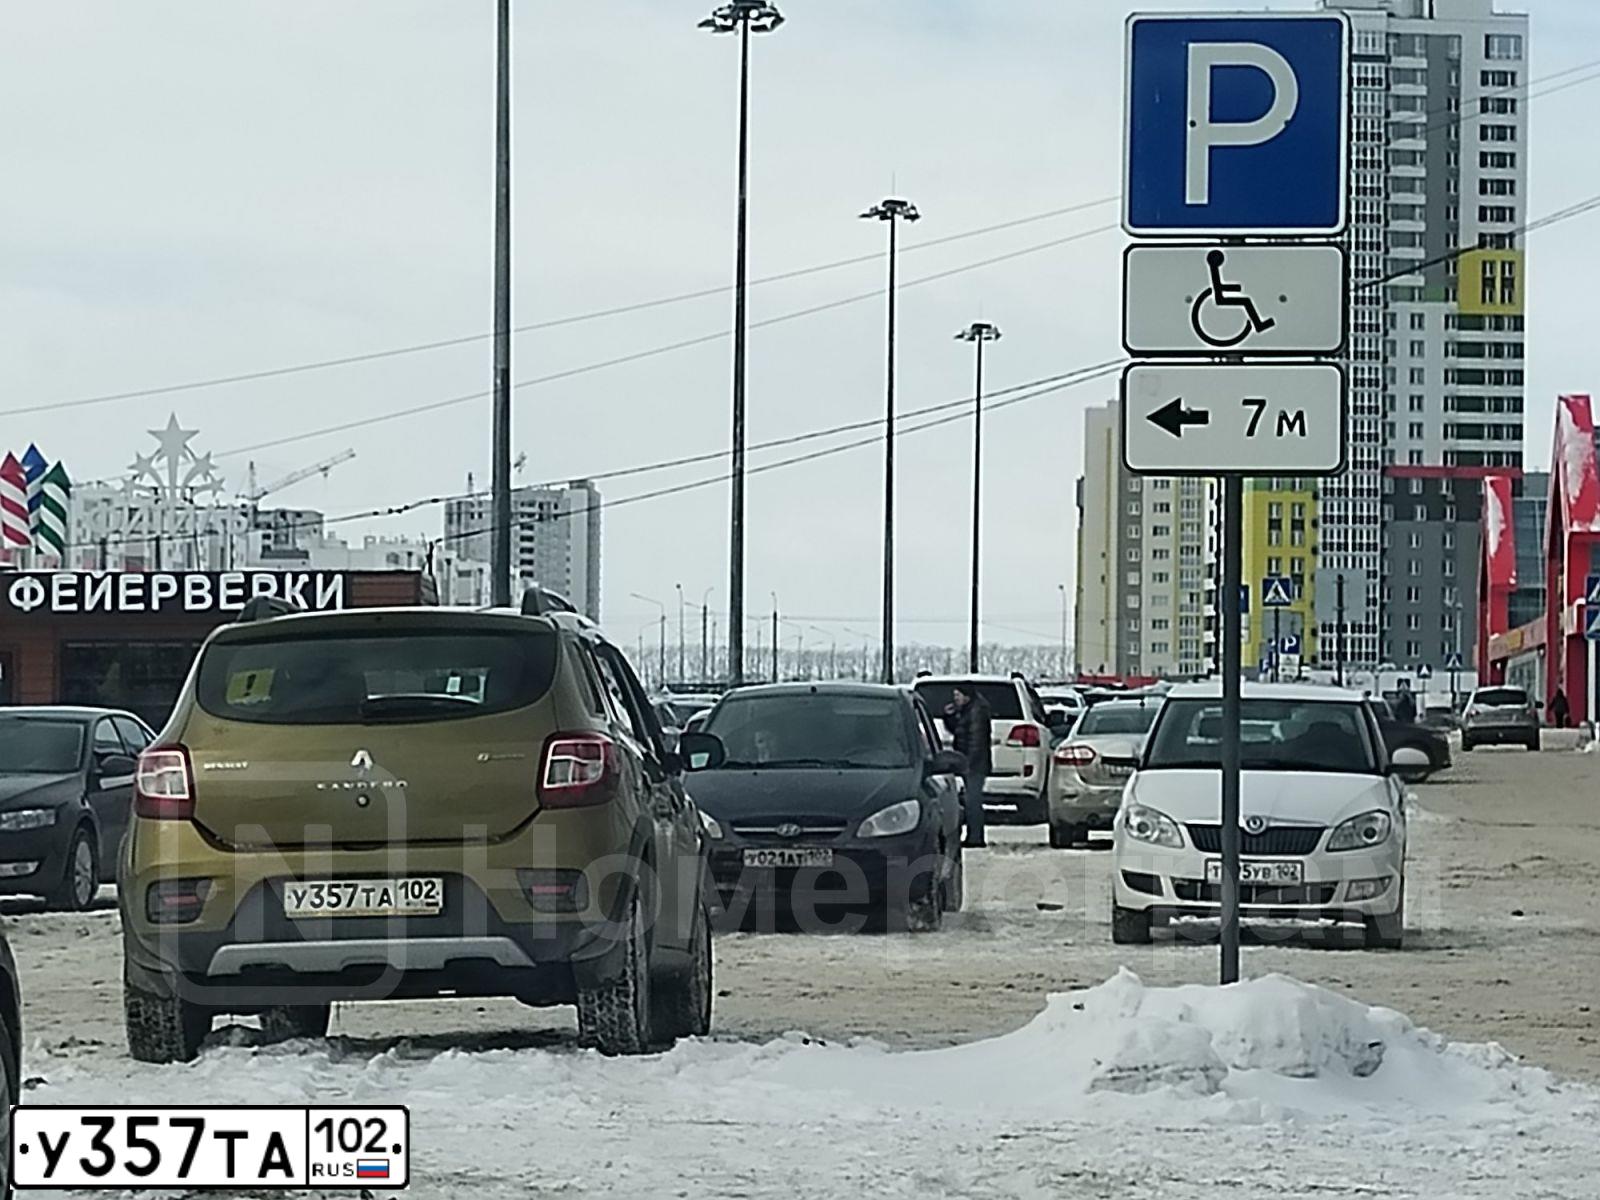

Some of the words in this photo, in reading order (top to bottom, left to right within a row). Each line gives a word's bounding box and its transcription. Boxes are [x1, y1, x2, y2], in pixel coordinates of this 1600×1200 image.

[1185, 42, 1299, 204] P
[1242, 398, 1267, 437] 7
[8, 572, 344, 611] ФЕЙЕРВЕРКИ
[1212, 864, 1272, 880] Т5УВ
[291, 883, 394, 909] У357ТА
[399, 880, 436, 900] 102
